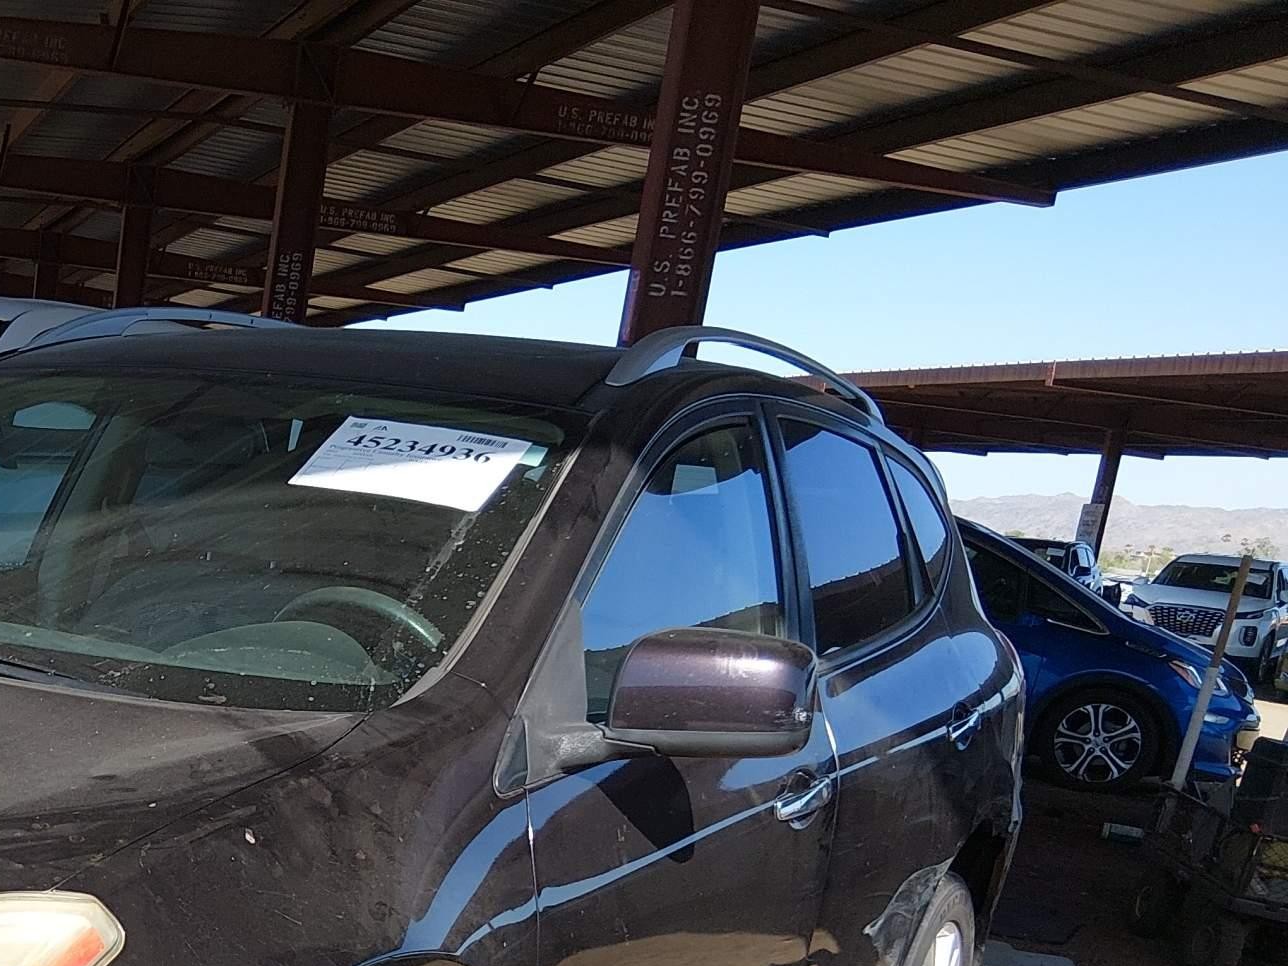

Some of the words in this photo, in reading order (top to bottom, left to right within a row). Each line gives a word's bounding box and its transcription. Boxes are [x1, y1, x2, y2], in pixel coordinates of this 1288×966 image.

[588, 109, 639, 128] PREFAB
[659, 147, 691, 239] PREFAB
[670, 93, 722, 297] 1-866-799-0969
[342, 207, 377, 221] PREFAB
[345, 434, 497, 464] 45234936
